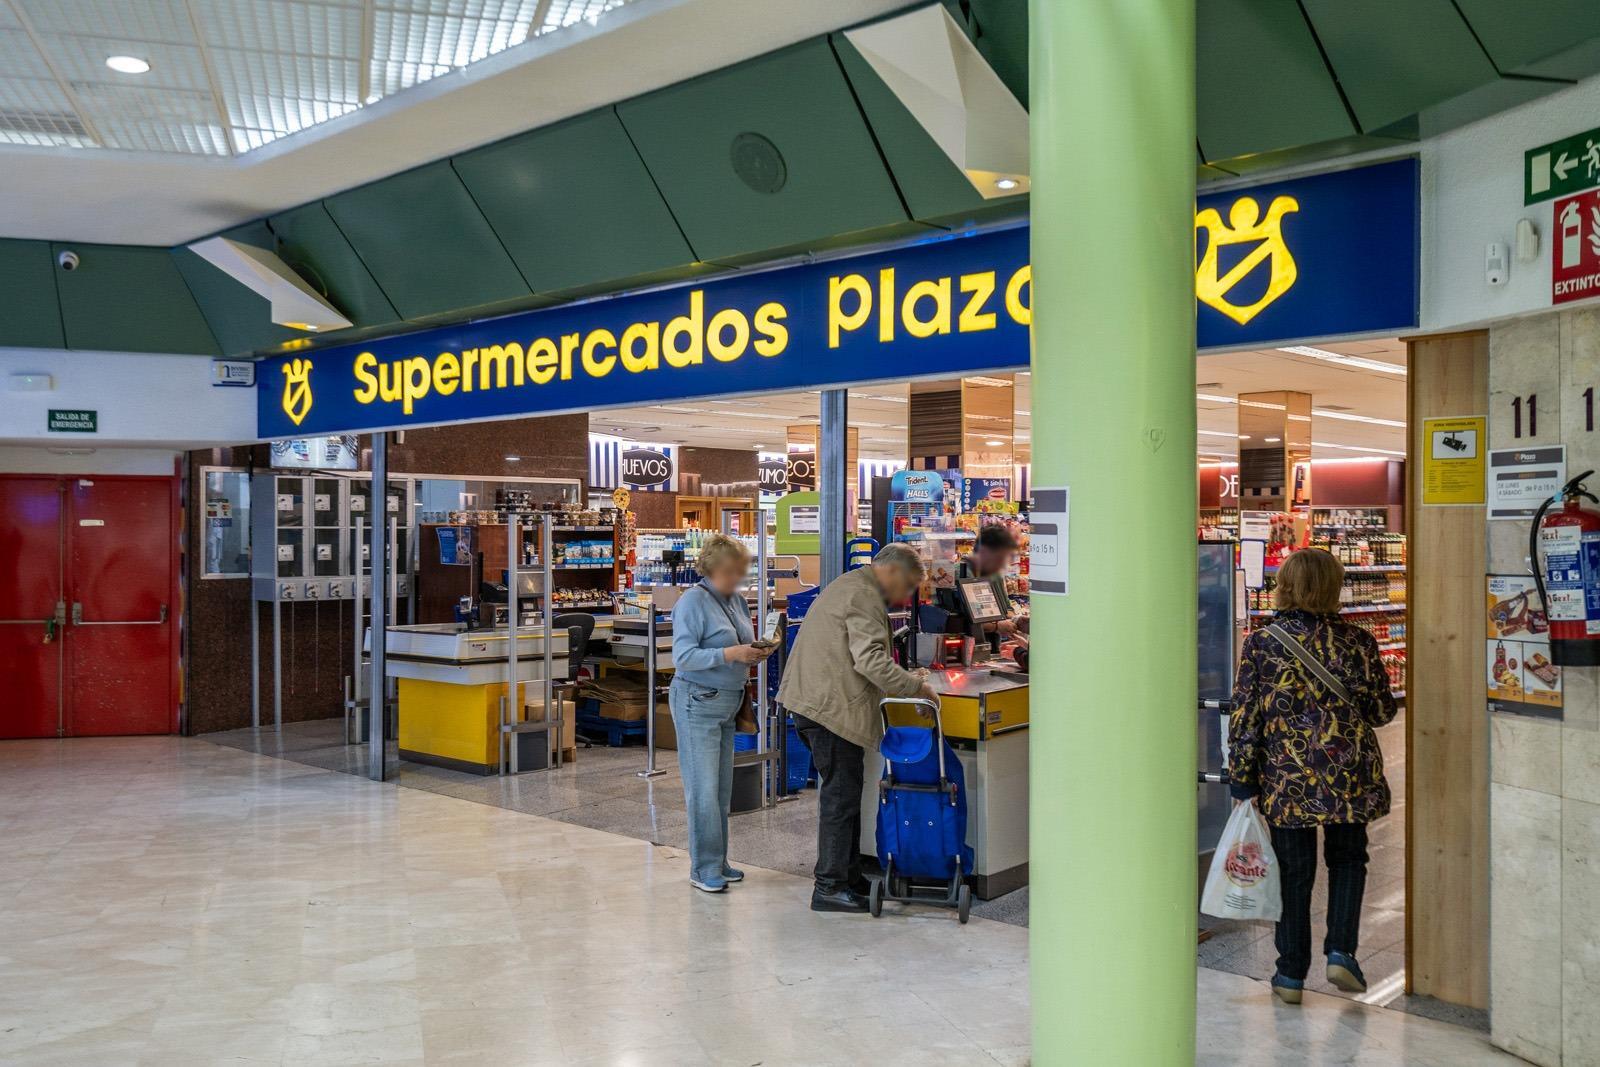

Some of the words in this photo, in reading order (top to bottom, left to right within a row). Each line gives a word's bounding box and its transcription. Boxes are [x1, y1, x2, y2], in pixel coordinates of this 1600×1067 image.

[354, 290, 789, 415] Supermercados
[1582, 387, 1593, 432] 1
[80, 413, 90, 421] DE
[1511, 393, 1537, 438] 11
[51, 420, 94, 428] EMERGENCIA
[906, 476, 928, 485] Trident
[907, 490, 928, 498] HALLS
[1041, 544, 1048, 553] 15
[1049, 545, 1055, 553] h
